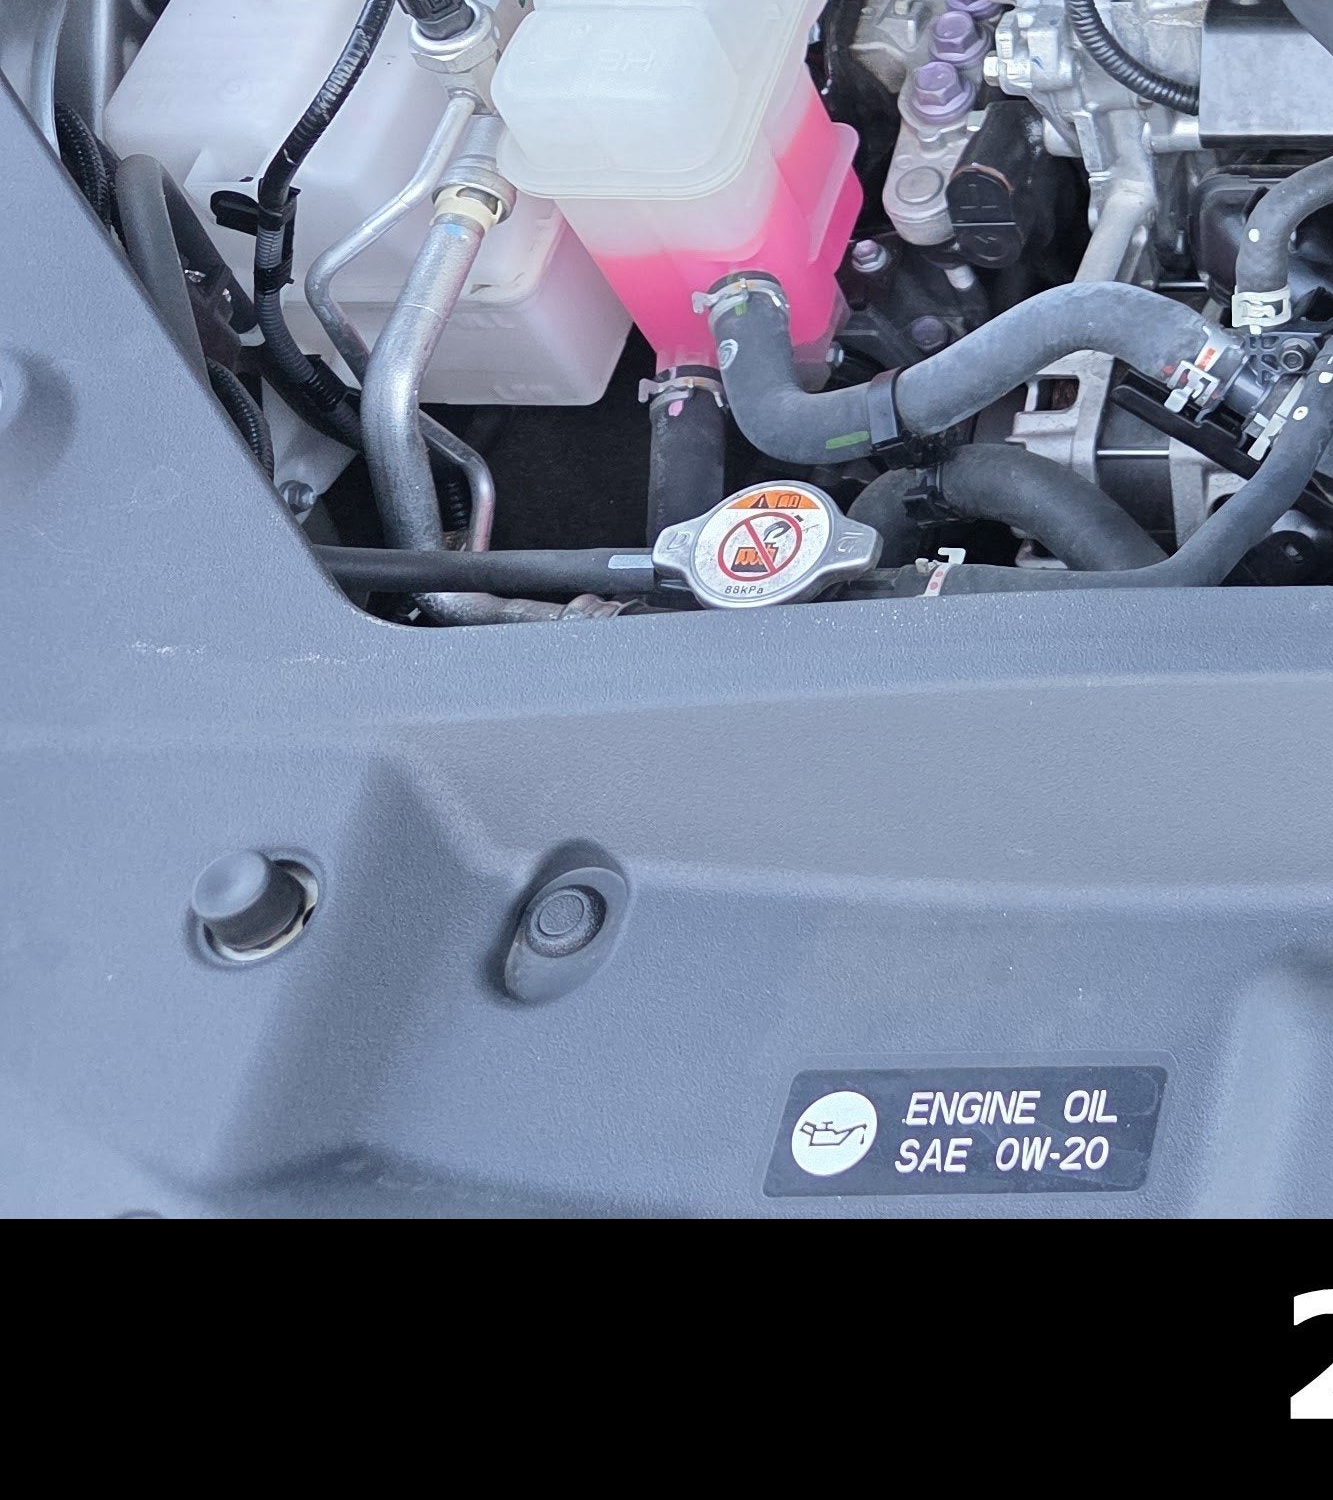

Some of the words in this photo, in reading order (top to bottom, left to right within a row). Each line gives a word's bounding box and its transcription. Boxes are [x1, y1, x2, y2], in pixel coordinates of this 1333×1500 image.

[724, 585, 764, 595] 88kPa
[905, 1090, 1041, 1126] ENGINE
[1063, 1089, 1118, 1124] OIL
[894, 1137, 973, 1174] SAE
[995, 1136, 1110, 1172] 0W-20
